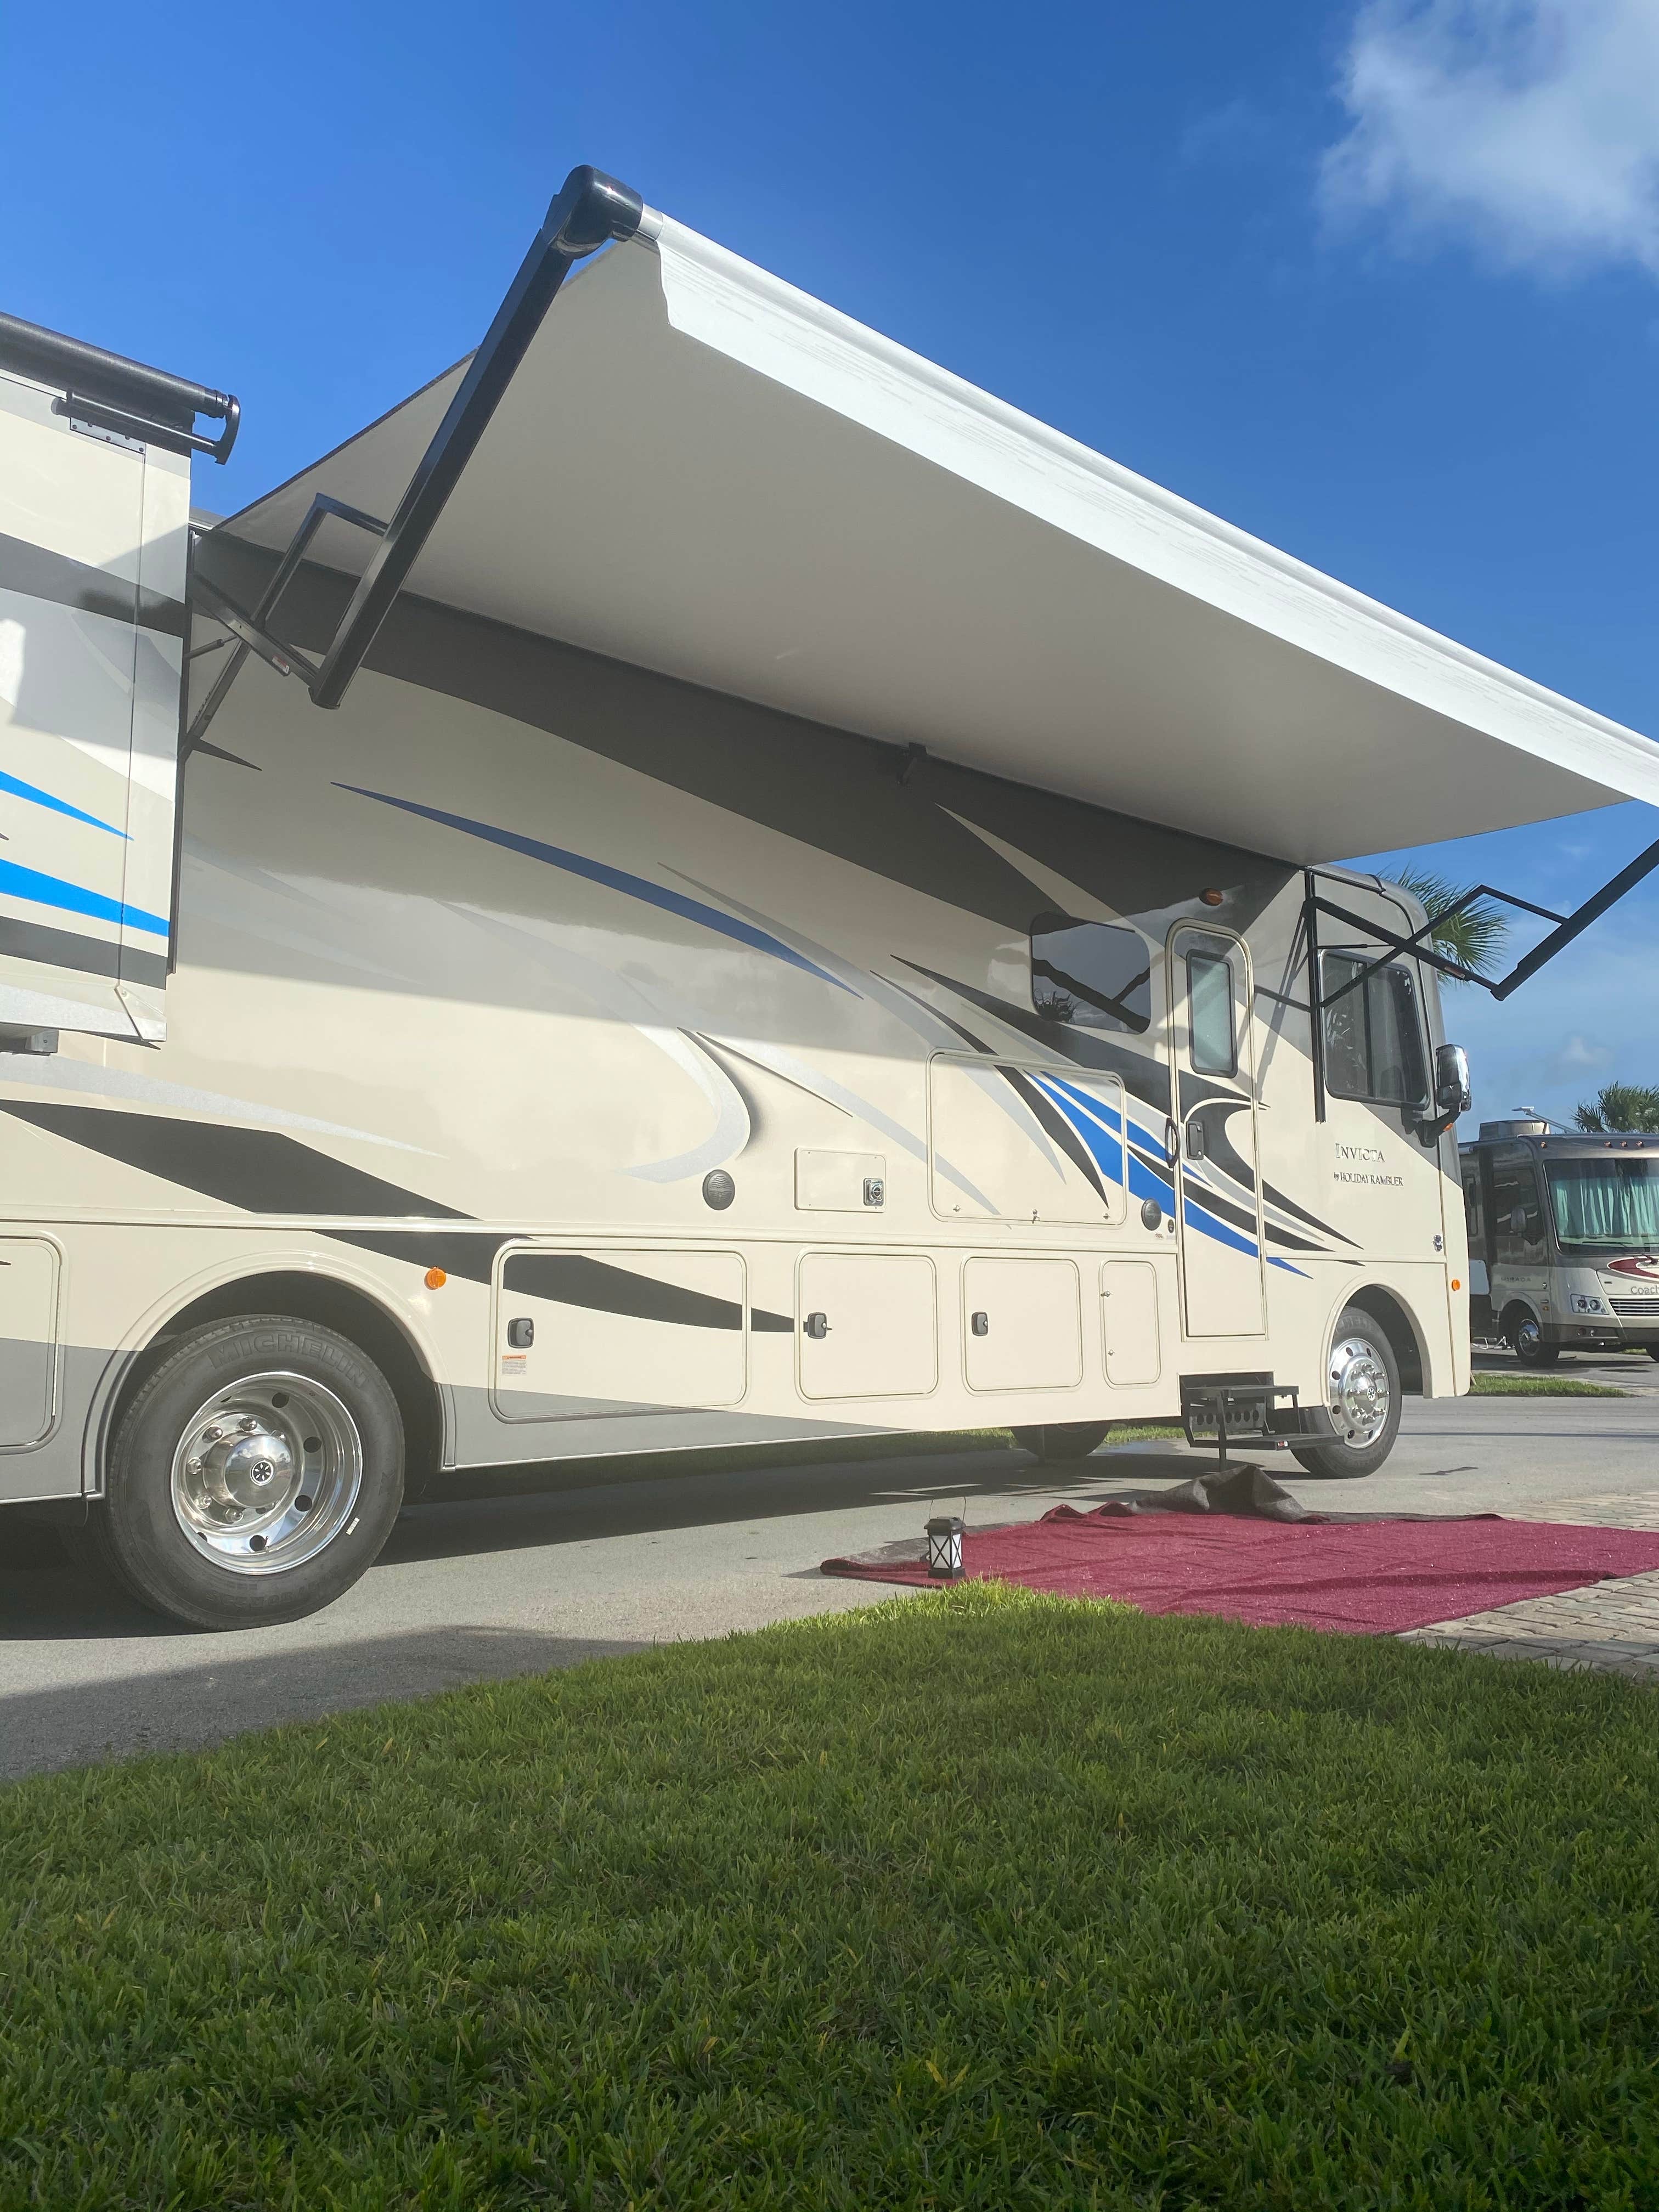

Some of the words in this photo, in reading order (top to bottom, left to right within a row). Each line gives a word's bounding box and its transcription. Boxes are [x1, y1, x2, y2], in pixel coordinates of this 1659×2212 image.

[1335, 1143, 1385, 1163] INVICTA
[1334, 1172, 1339, 1181] by
[1340, 1172, 1370, 1184] HOLIDAY
[1370, 1175, 1404, 1186] RAMBLER
[207, 1334, 367, 1387] MICHELIN
